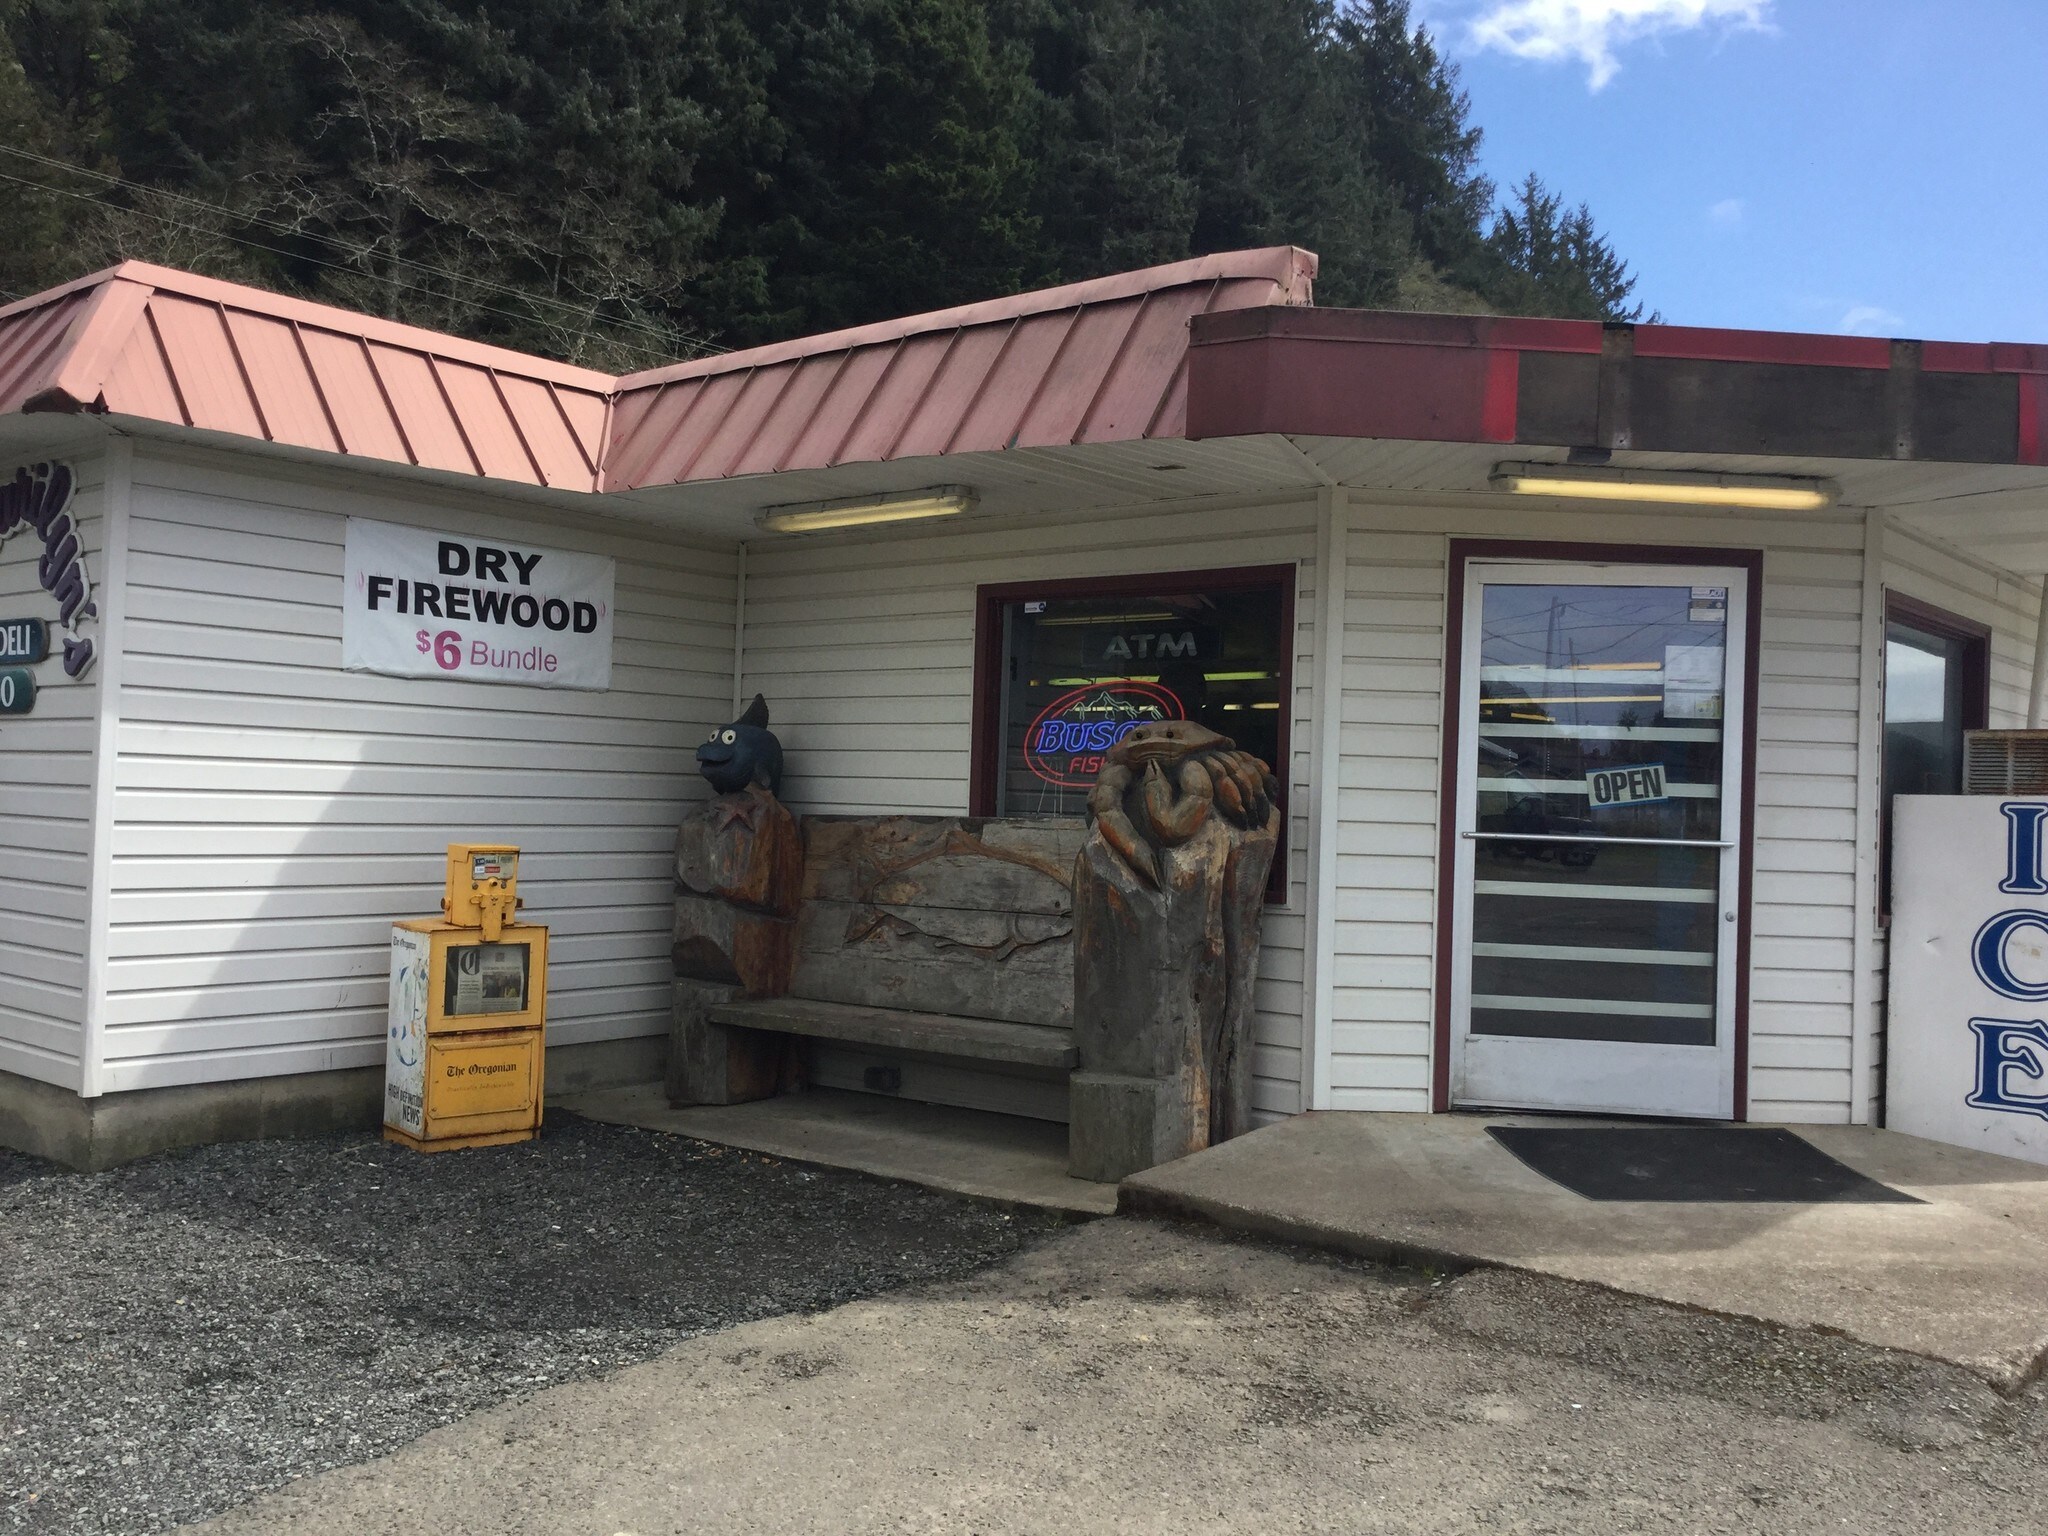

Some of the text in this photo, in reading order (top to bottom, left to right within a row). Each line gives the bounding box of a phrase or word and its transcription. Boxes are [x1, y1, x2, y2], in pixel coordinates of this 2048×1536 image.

[438, 541, 543, 585] DRY
[367, 575, 598, 634] FIREWOOD
[416, 629, 558, 672] $6 Bundle
[1103, 632, 1198, 660] ATM
[1036, 720, 1152, 752] BUSC
[1593, 767, 1663, 804] OPEN
[1964, 801, 2048, 1122] ICE
[446, 1063, 517, 1078] The Oregonian
[402, 1104, 421, 1126] NEWS
